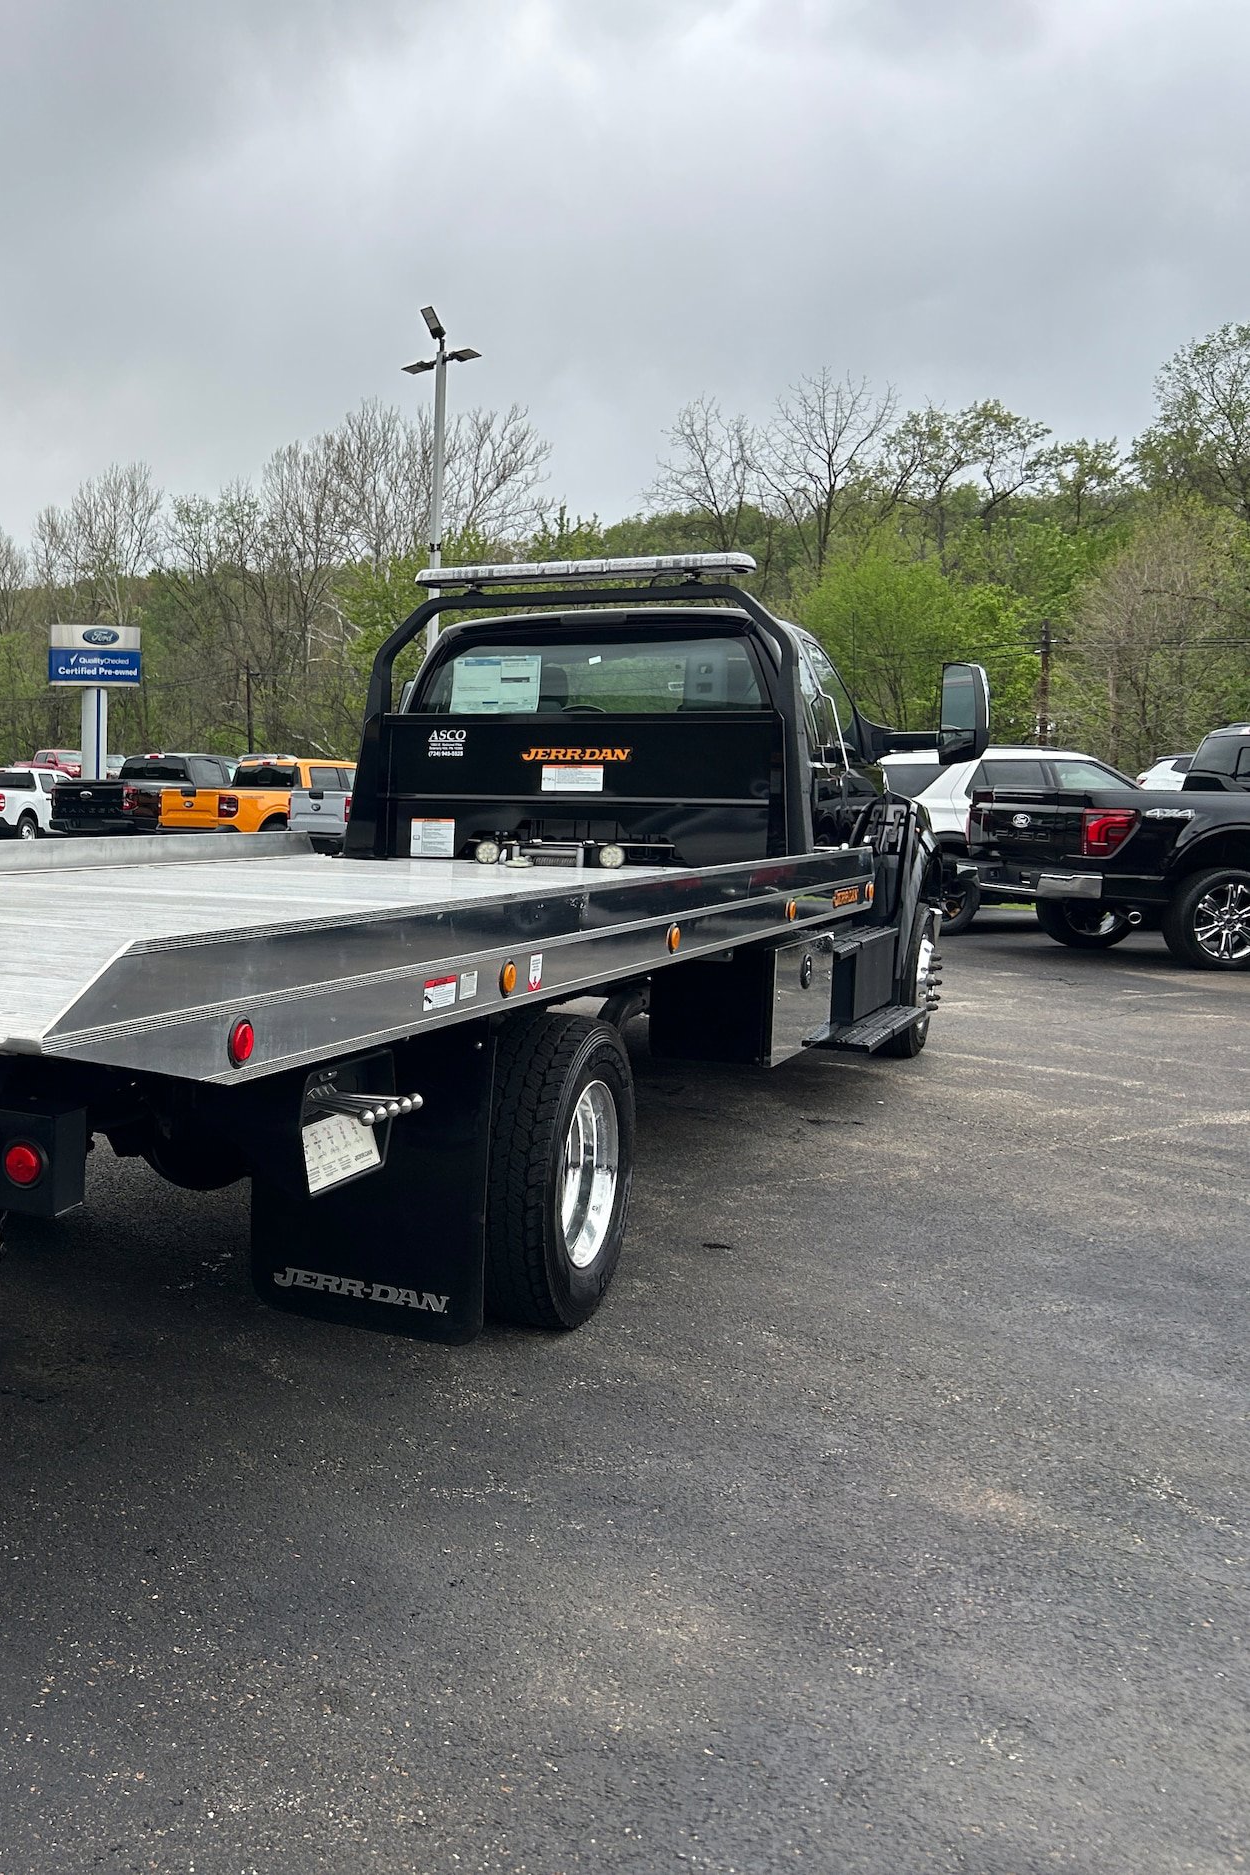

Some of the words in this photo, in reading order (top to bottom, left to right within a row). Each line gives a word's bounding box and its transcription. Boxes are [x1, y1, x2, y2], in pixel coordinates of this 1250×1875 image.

[91, 631, 114, 641] Ford
[58, 667, 97, 675] Certified
[98, 667, 138, 676] Pre-owned
[428, 729, 467, 740] ASCO
[521, 748, 631, 761] JERR-DAN
[273, 1267, 449, 1313] JERR-DAN
